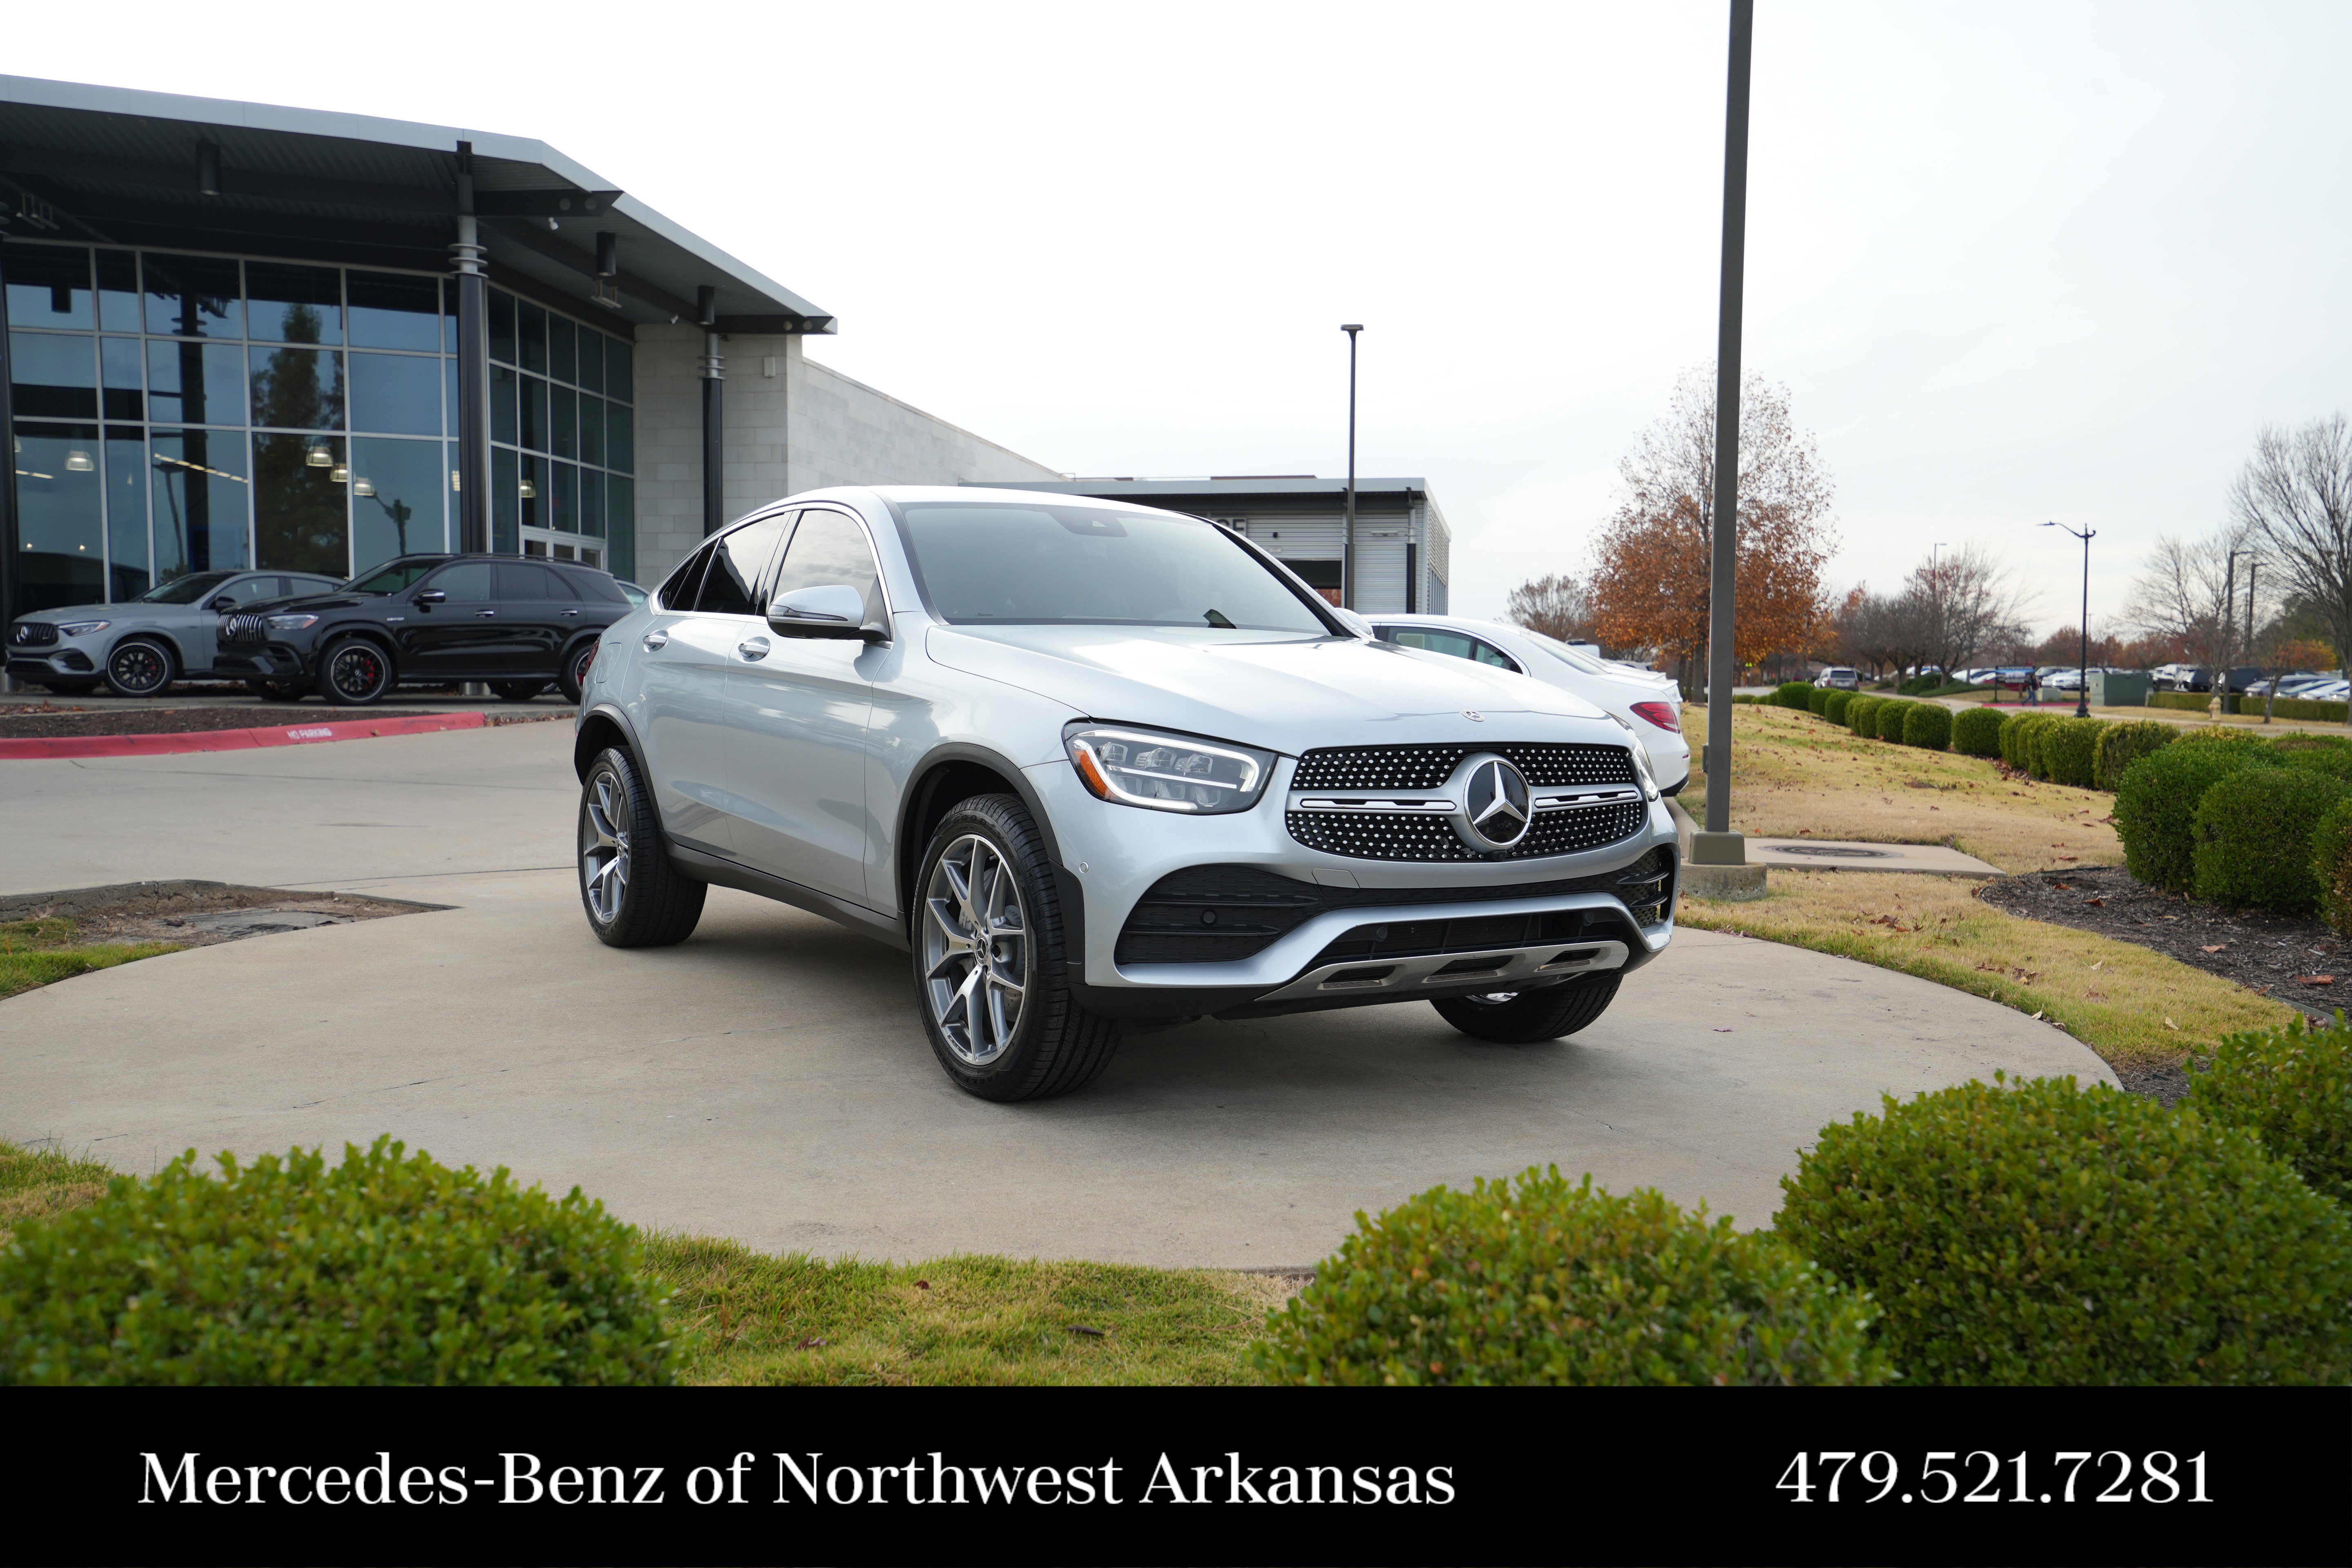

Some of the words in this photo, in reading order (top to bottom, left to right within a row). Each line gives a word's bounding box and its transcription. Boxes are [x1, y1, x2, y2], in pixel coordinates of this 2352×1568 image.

[287, 730, 301, 739] NO
[298, 728, 332, 738] PARKING
[964, 1071, 1000, 1085] EAGLE
